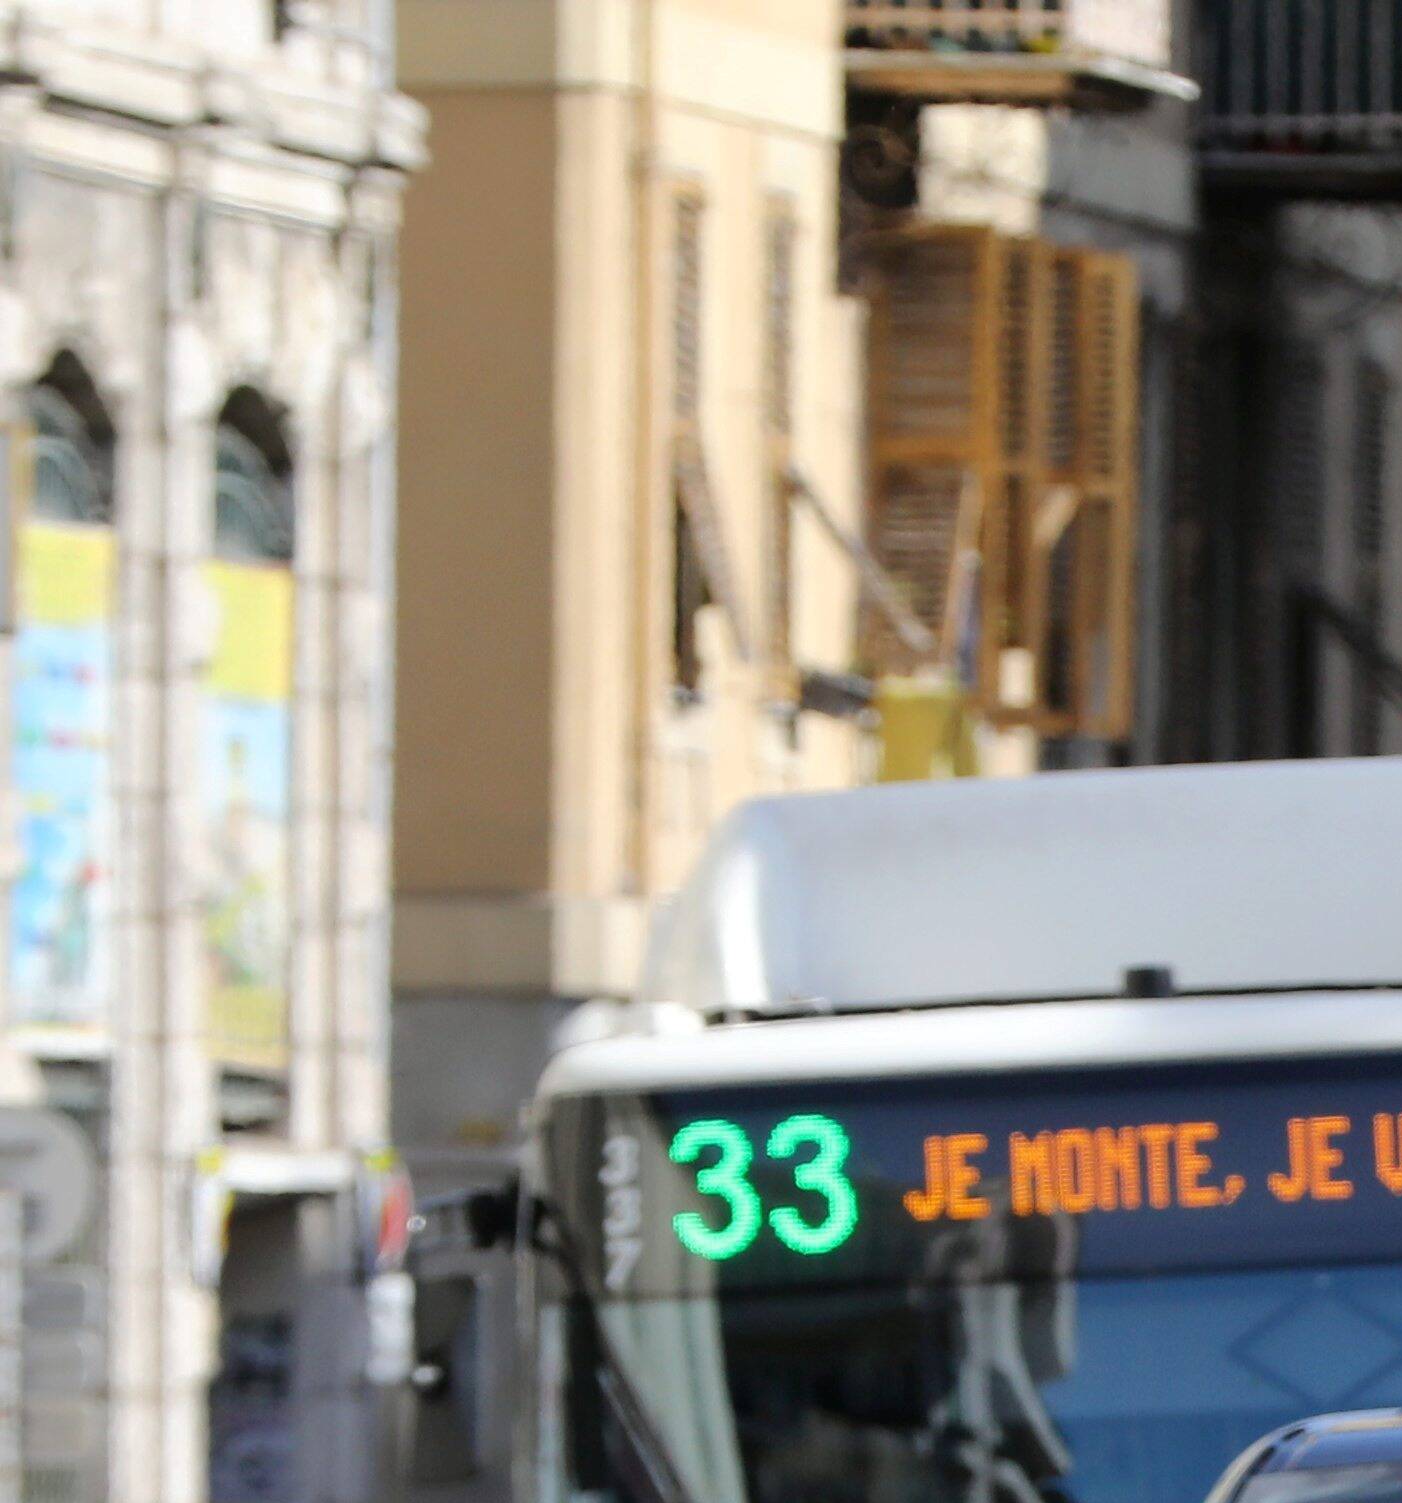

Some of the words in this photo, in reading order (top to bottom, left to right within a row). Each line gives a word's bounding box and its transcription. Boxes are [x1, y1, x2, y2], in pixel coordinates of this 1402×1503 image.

[598, 1135, 642, 1291] 337
[668, 1113, 859, 1262] 33
[903, 1133, 992, 1221] JE
[1009, 1121, 1246, 1217] MONTE,
[1267, 1115, 1354, 1202] JE
